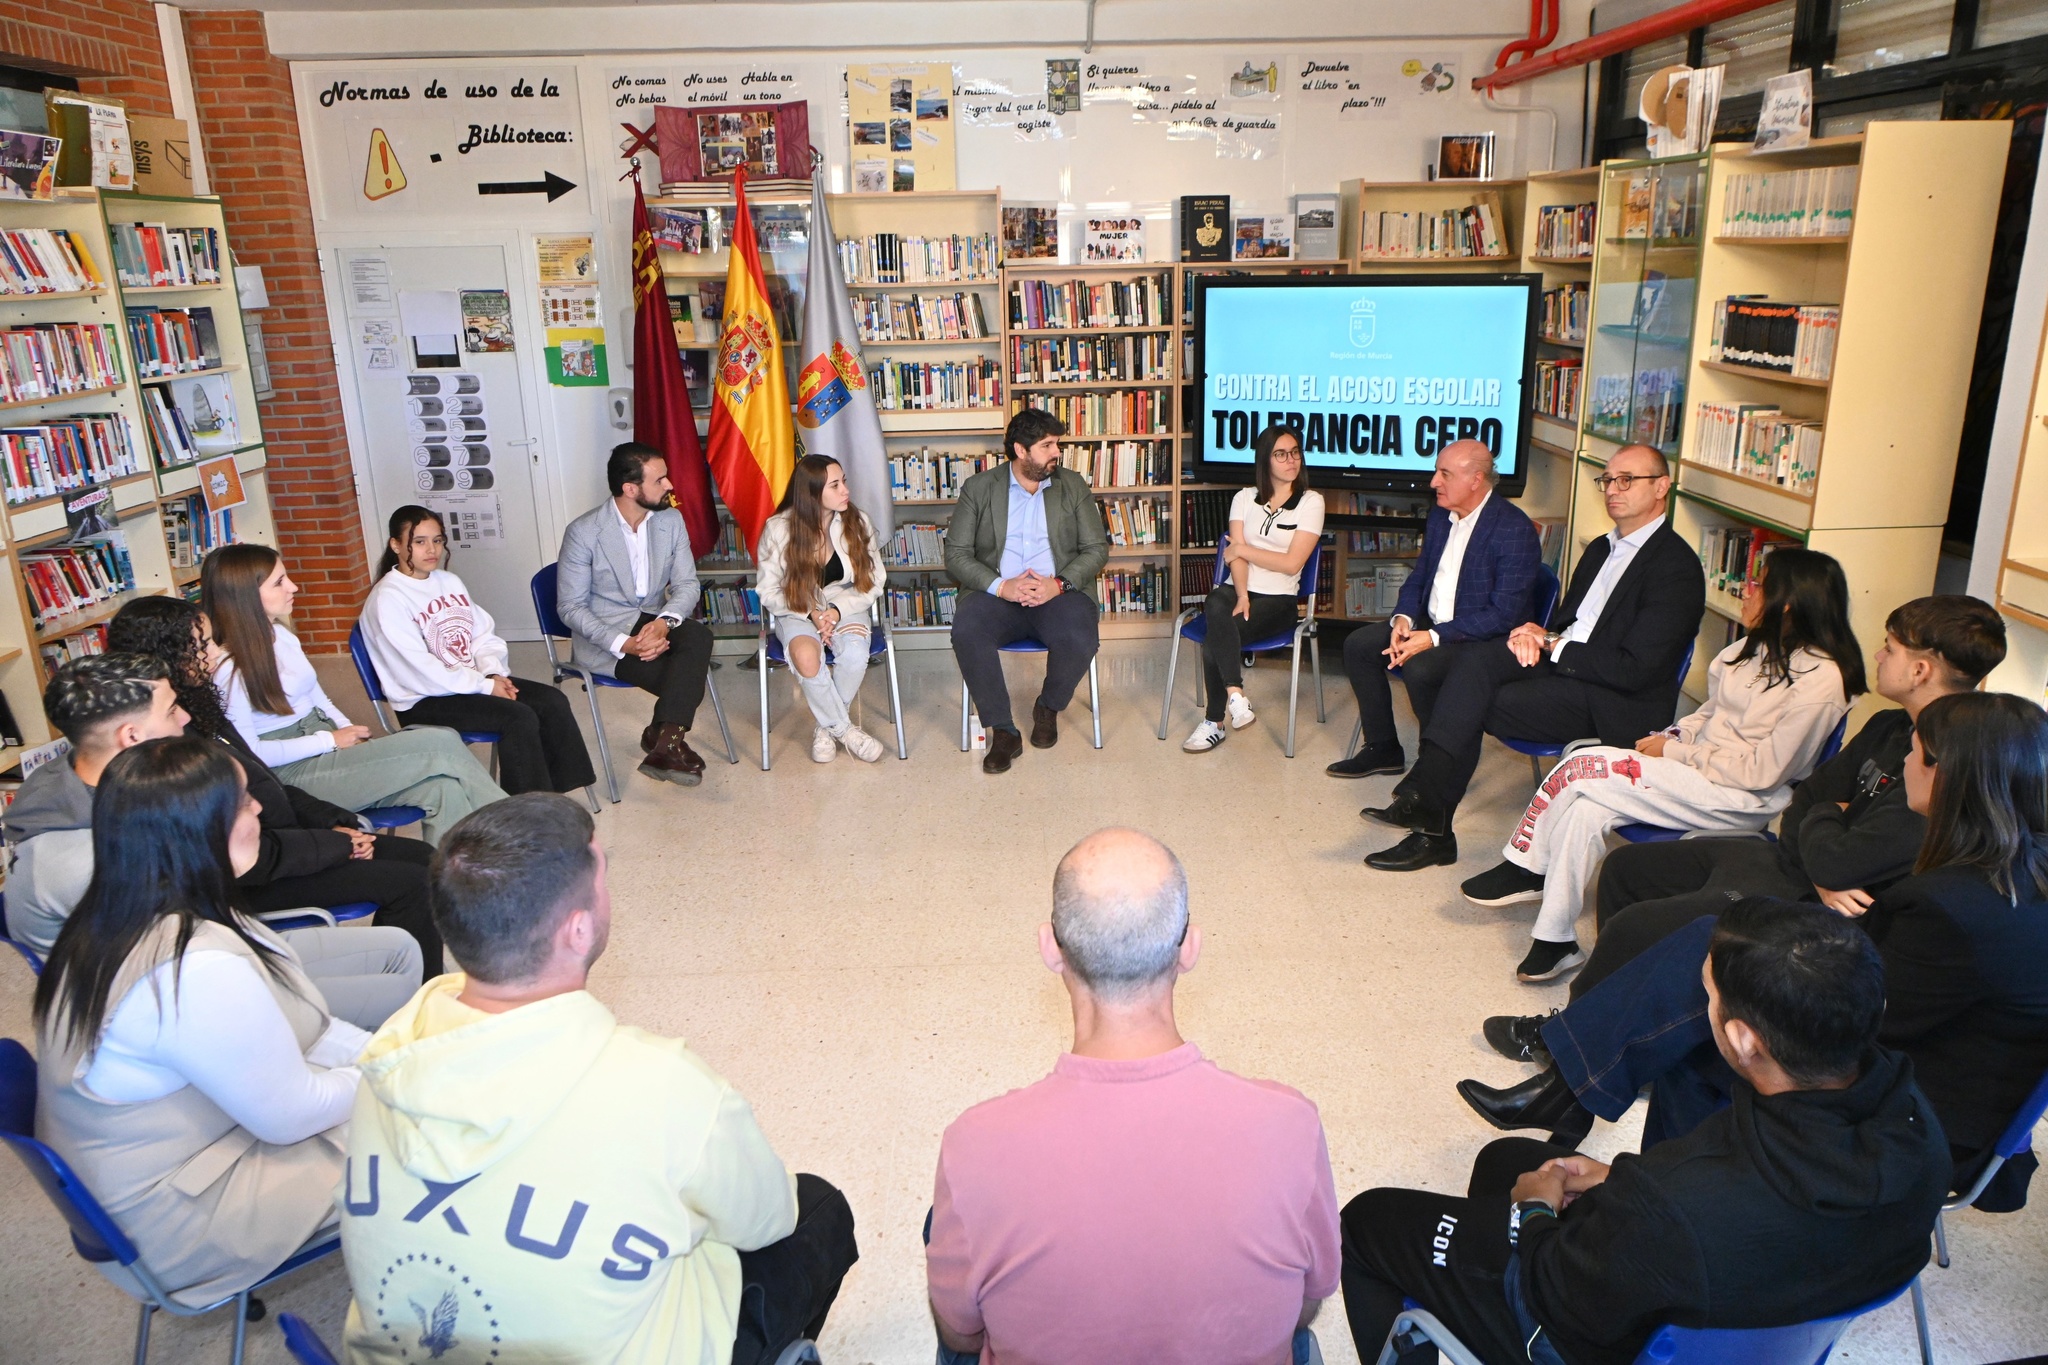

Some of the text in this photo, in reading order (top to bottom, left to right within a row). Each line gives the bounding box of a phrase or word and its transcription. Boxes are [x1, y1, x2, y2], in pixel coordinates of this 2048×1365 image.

[1087, 64, 1138, 79] Si quieres
[1301, 61, 1350, 77] Devuelve
[612, 76, 666, 89] No comas
[684, 73, 727, 87] No uses
[741, 71, 792, 85] Habla en
[1302, 79, 1311, 90] el
[1314, 79, 1338, 90] libro
[319, 78, 560, 107] Normas de uso de la
[615, 93, 666, 107] No bebas
[688, 91, 727, 102] el móvil
[760, 92, 781, 100] tono
[995, 102, 1012, 112] del
[1016, 104, 1034, 116] que
[1037, 100, 1046, 110] lo
[1205, 100, 1217, 110] al
[1017, 120, 1051, 133] cogiste
[1222, 118, 1234, 128] de
[1234, 119, 1276, 133] guardia
[458, 124, 574, 154] Biblioteca:
[1099, 232, 1128, 240] MUJER
[1356, 351, 1366, 359] de
[1367, 351, 1393, 360] Murcia
[1214, 373, 1502, 408] CONTRA EL ACOSO ESCOLAR
[445, 396, 462, 415] 2
[414, 445, 430, 467] 6
[453, 446, 469, 466] 7
[418, 469, 434, 490] 8
[456, 468, 473, 489] 9
[71, 491, 106, 509] AVENTURAS
[1541, 754, 1609, 800] CHICAGO
[1510, 795, 1549, 853] BULLS
[1432, 1214, 1458, 1267] ICON
